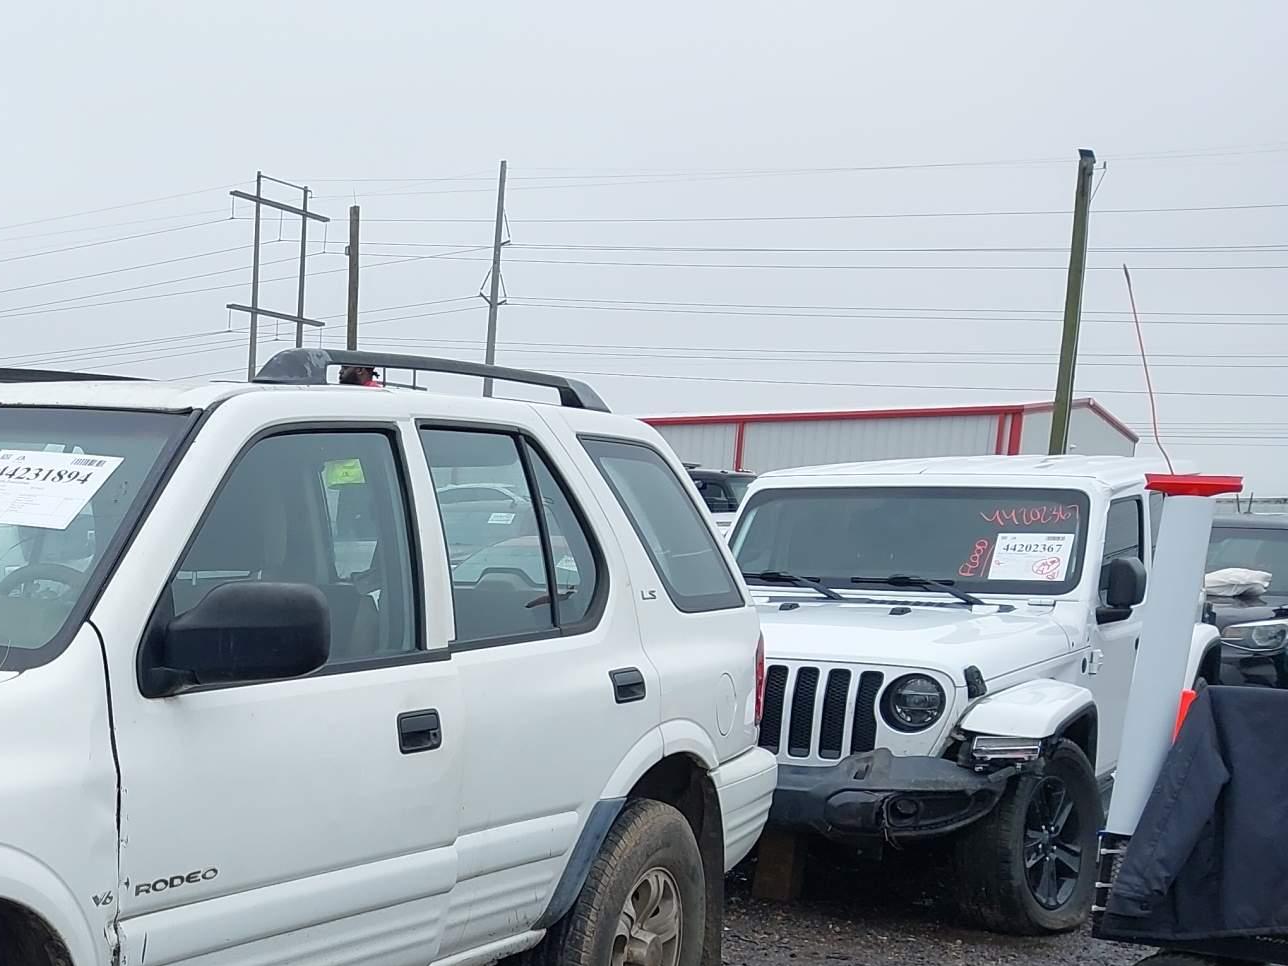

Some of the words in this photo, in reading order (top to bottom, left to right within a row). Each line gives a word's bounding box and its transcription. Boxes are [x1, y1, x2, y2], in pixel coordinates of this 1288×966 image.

[1002, 543, 1063, 554] 44202367
[640, 590, 657, 600] LS
[134, 867, 219, 897] RODEO
[92, 890, 114, 908] V6
